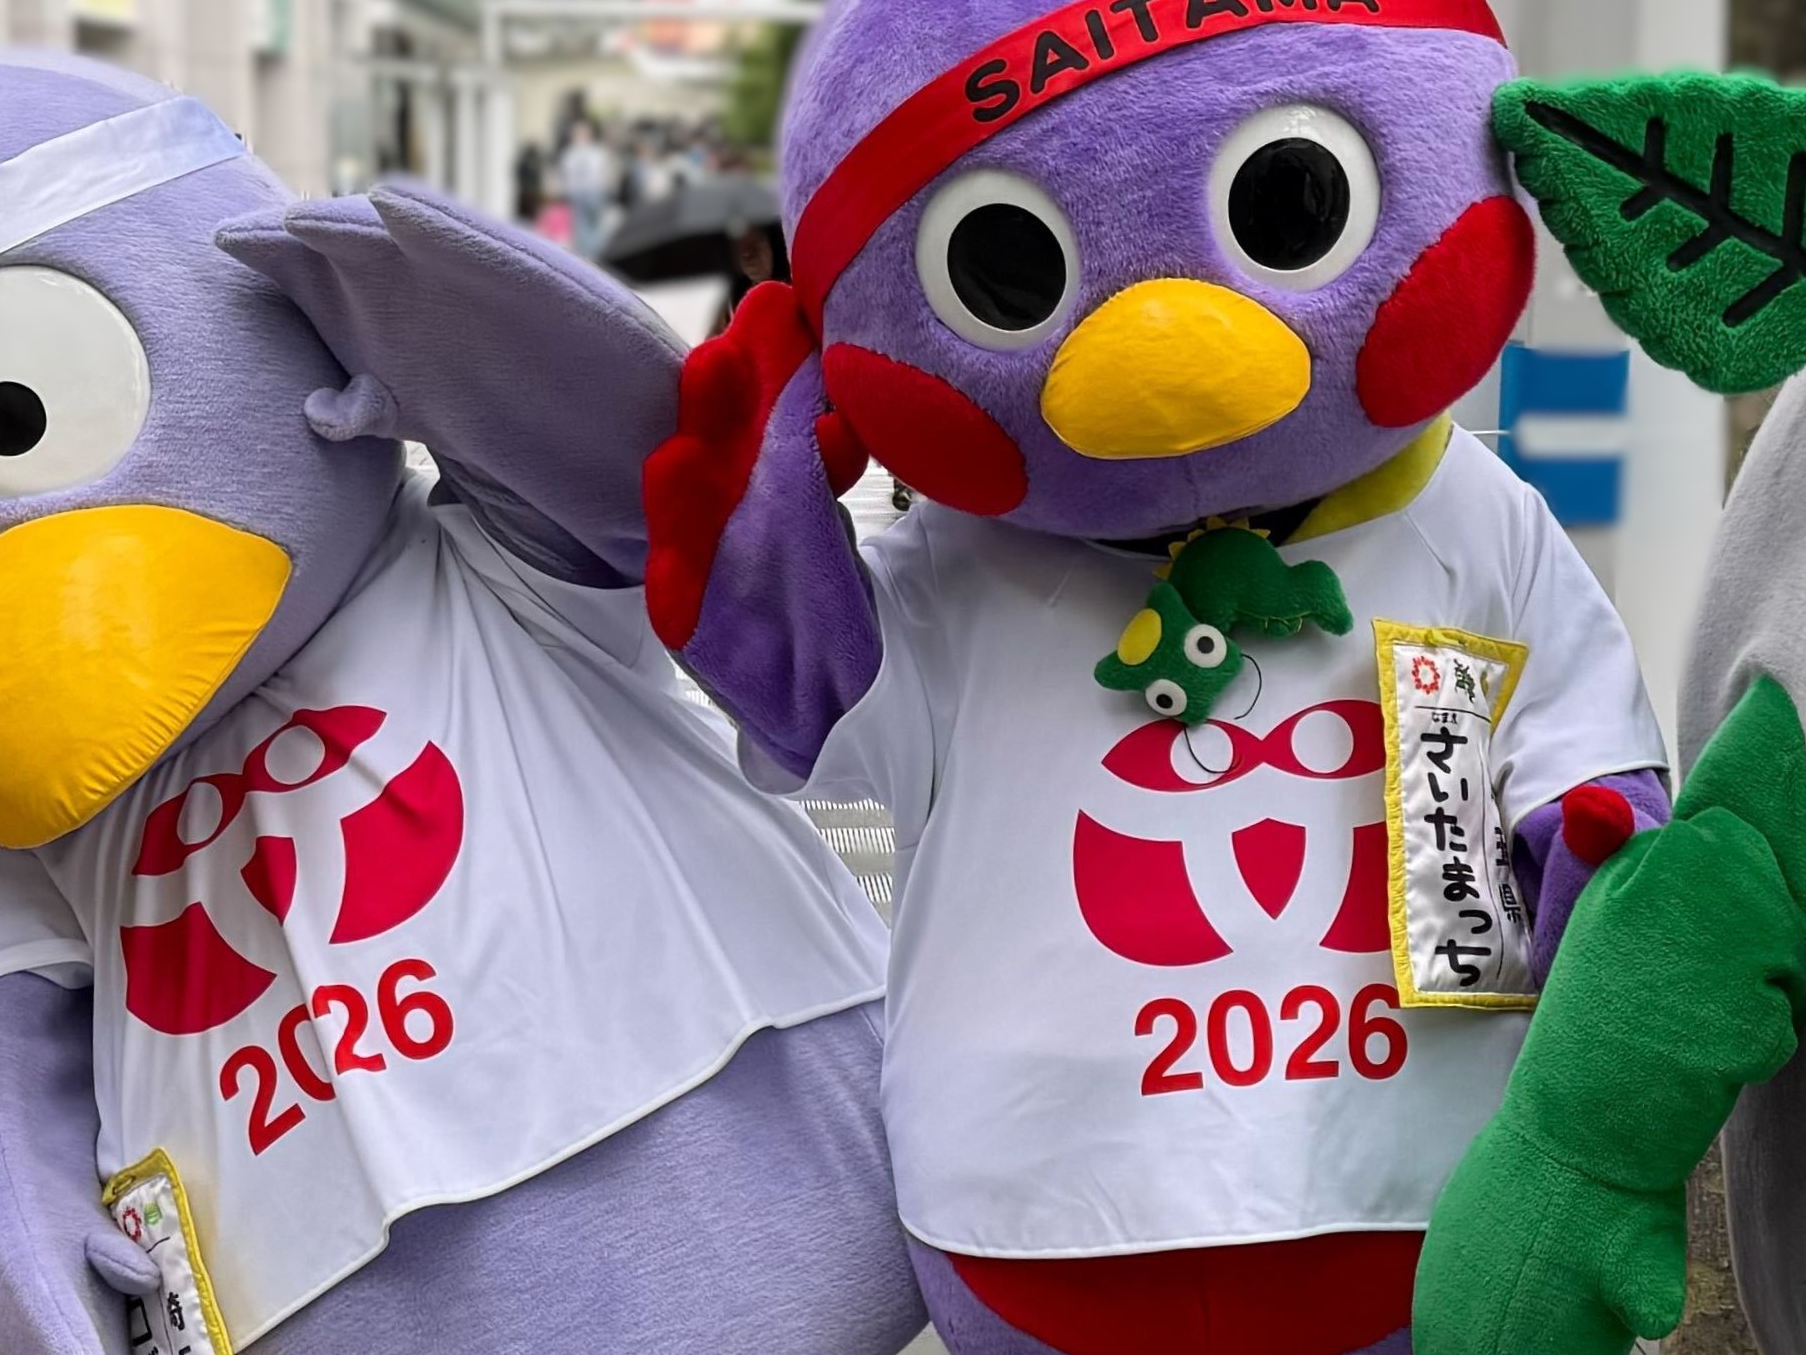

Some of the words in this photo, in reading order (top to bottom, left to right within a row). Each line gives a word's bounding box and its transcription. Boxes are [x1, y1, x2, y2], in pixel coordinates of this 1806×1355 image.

[1420, 726, 1493, 987] さいたまっち
[220, 958, 454, 1156] 2026
[1134, 983, 1409, 1096] 2026
